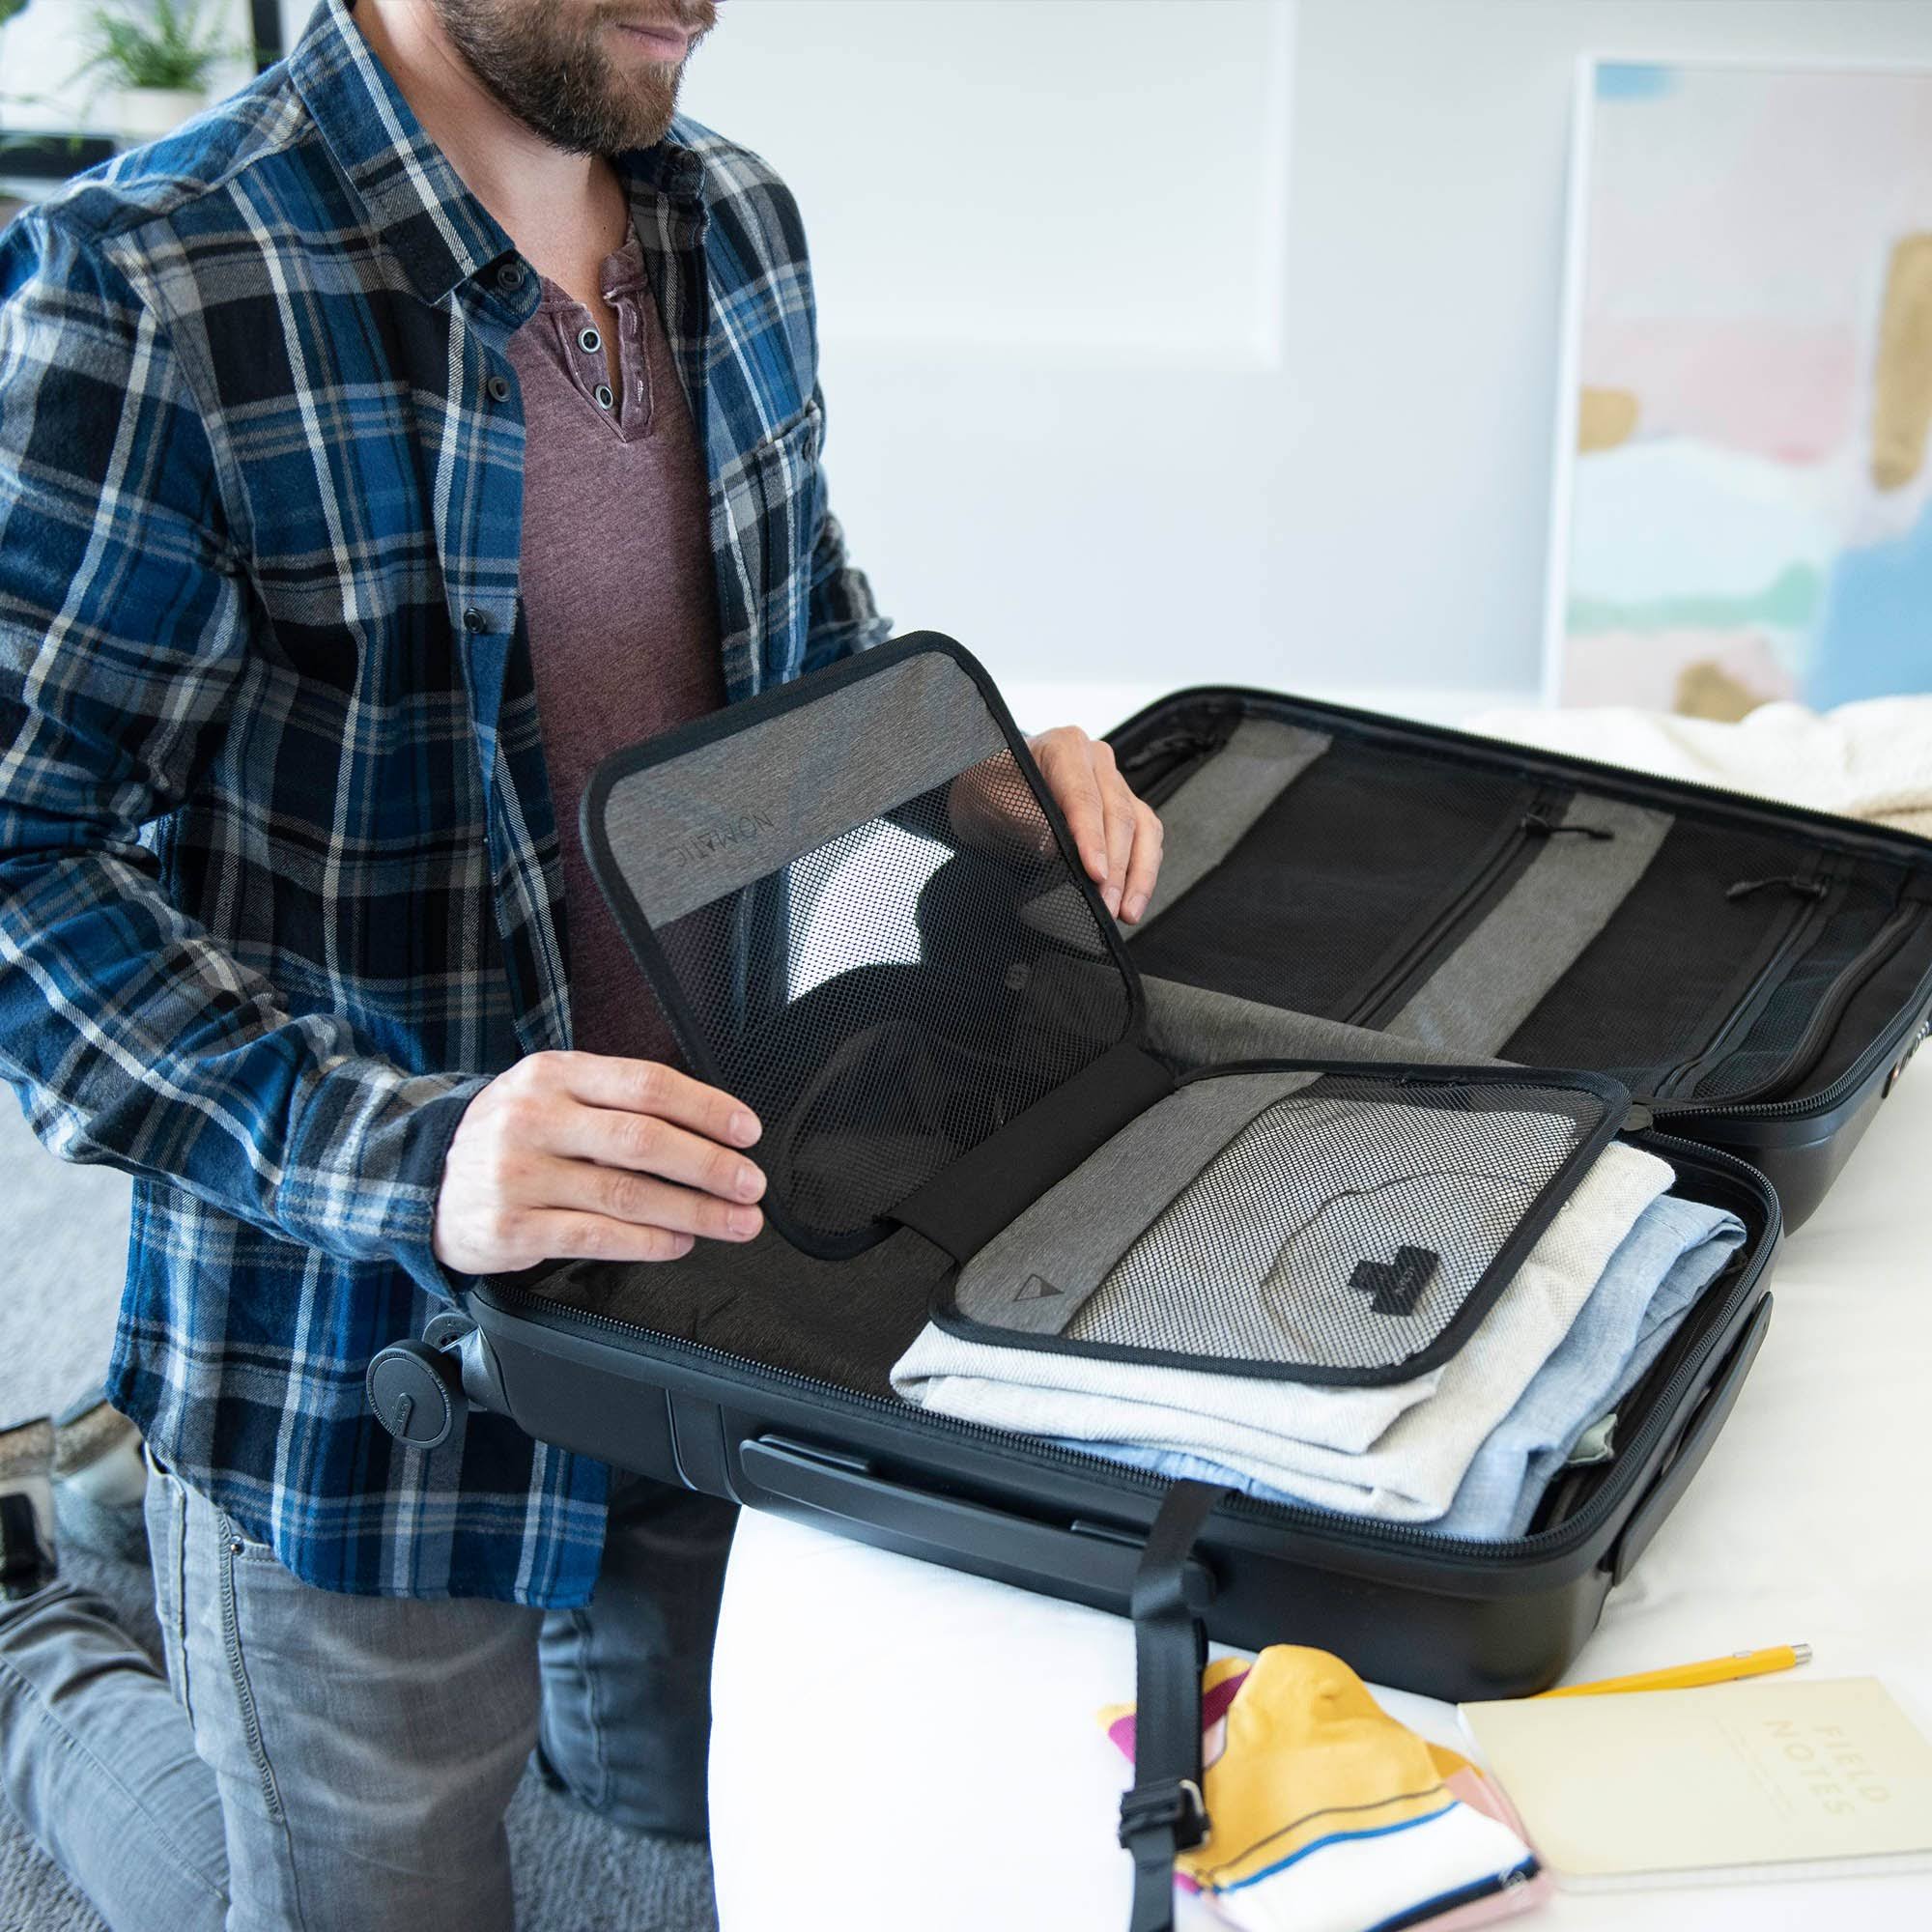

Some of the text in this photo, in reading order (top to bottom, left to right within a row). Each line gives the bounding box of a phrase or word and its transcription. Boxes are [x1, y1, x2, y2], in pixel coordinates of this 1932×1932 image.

[667, 811, 775, 867] NOMATIC
[1762, 1719, 1856, 1815] NOTES
[1811, 1724, 1890, 1803] FIELD
